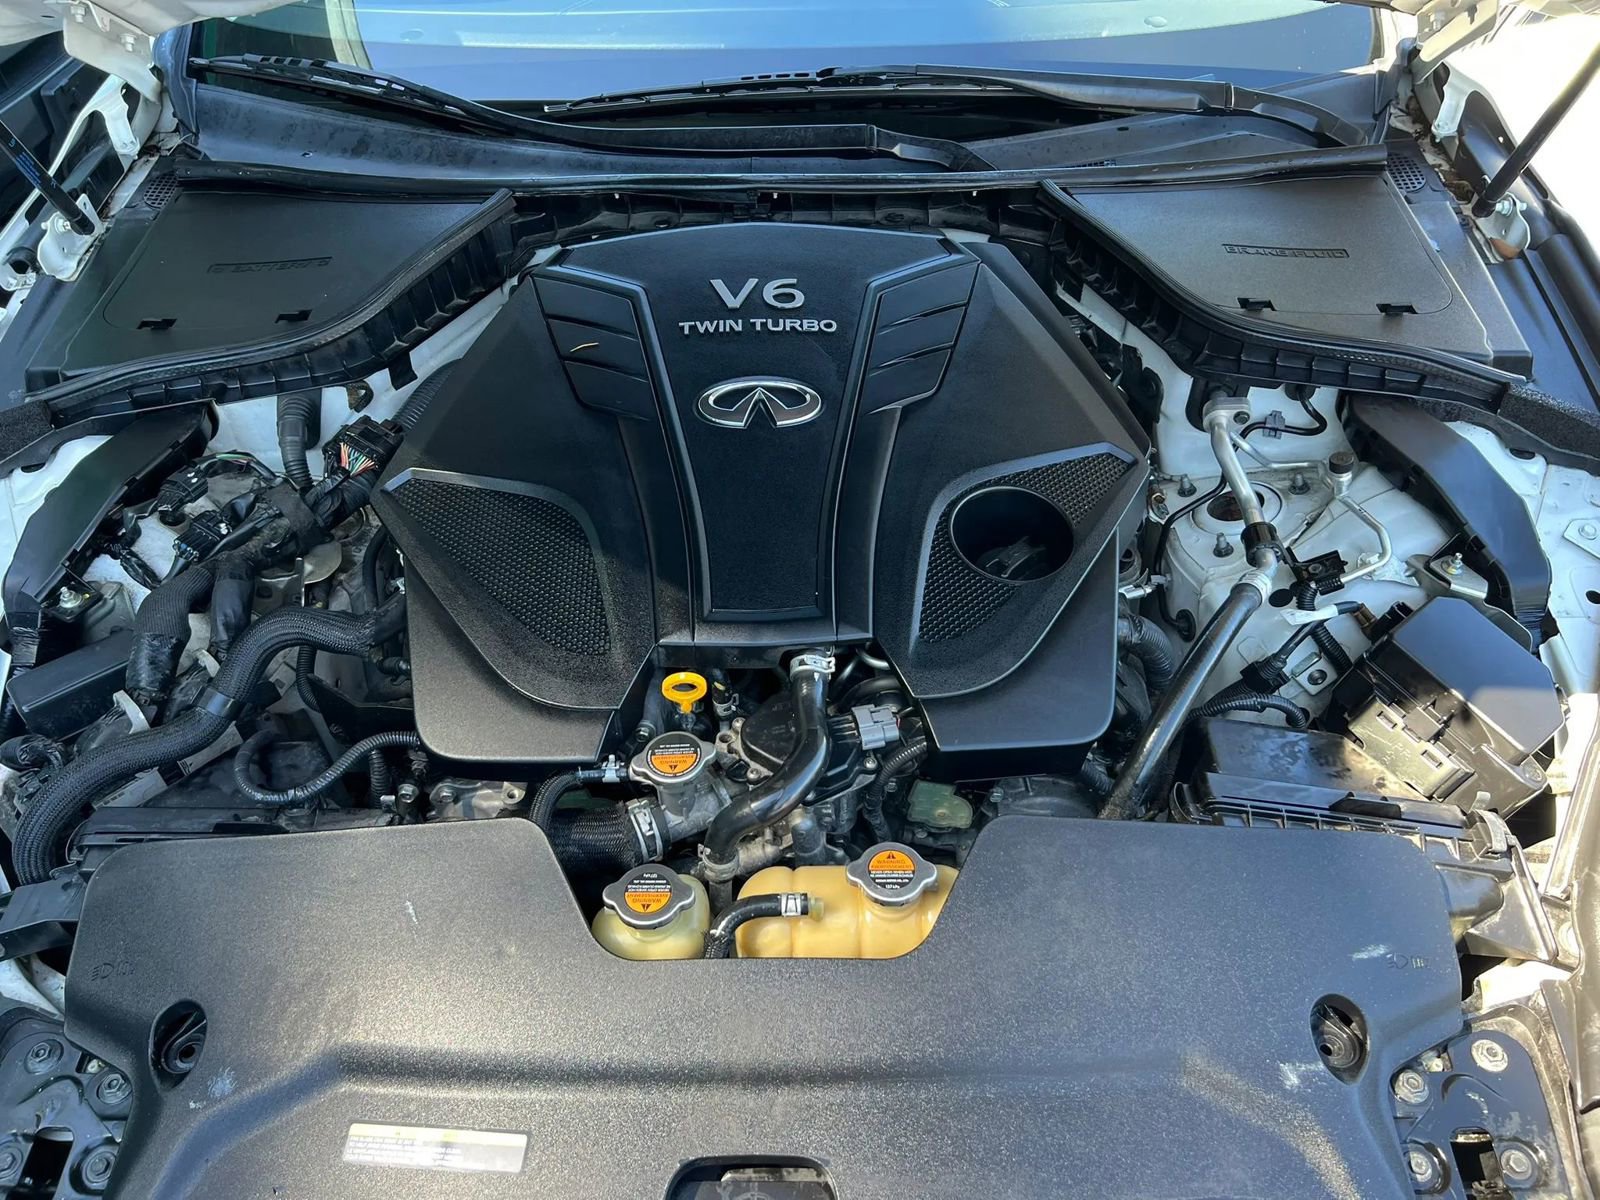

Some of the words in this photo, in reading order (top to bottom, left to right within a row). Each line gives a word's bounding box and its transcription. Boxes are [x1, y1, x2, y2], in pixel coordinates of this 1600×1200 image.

[1224, 246, 1288, 257] BRAKE
[1293, 249, 1346, 258] FLUID
[231, 260, 312, 273] BATTERY
[709, 278, 805, 310] V6
[678, 319, 743, 335] TWIN
[750, 318, 838, 333] TURBO
